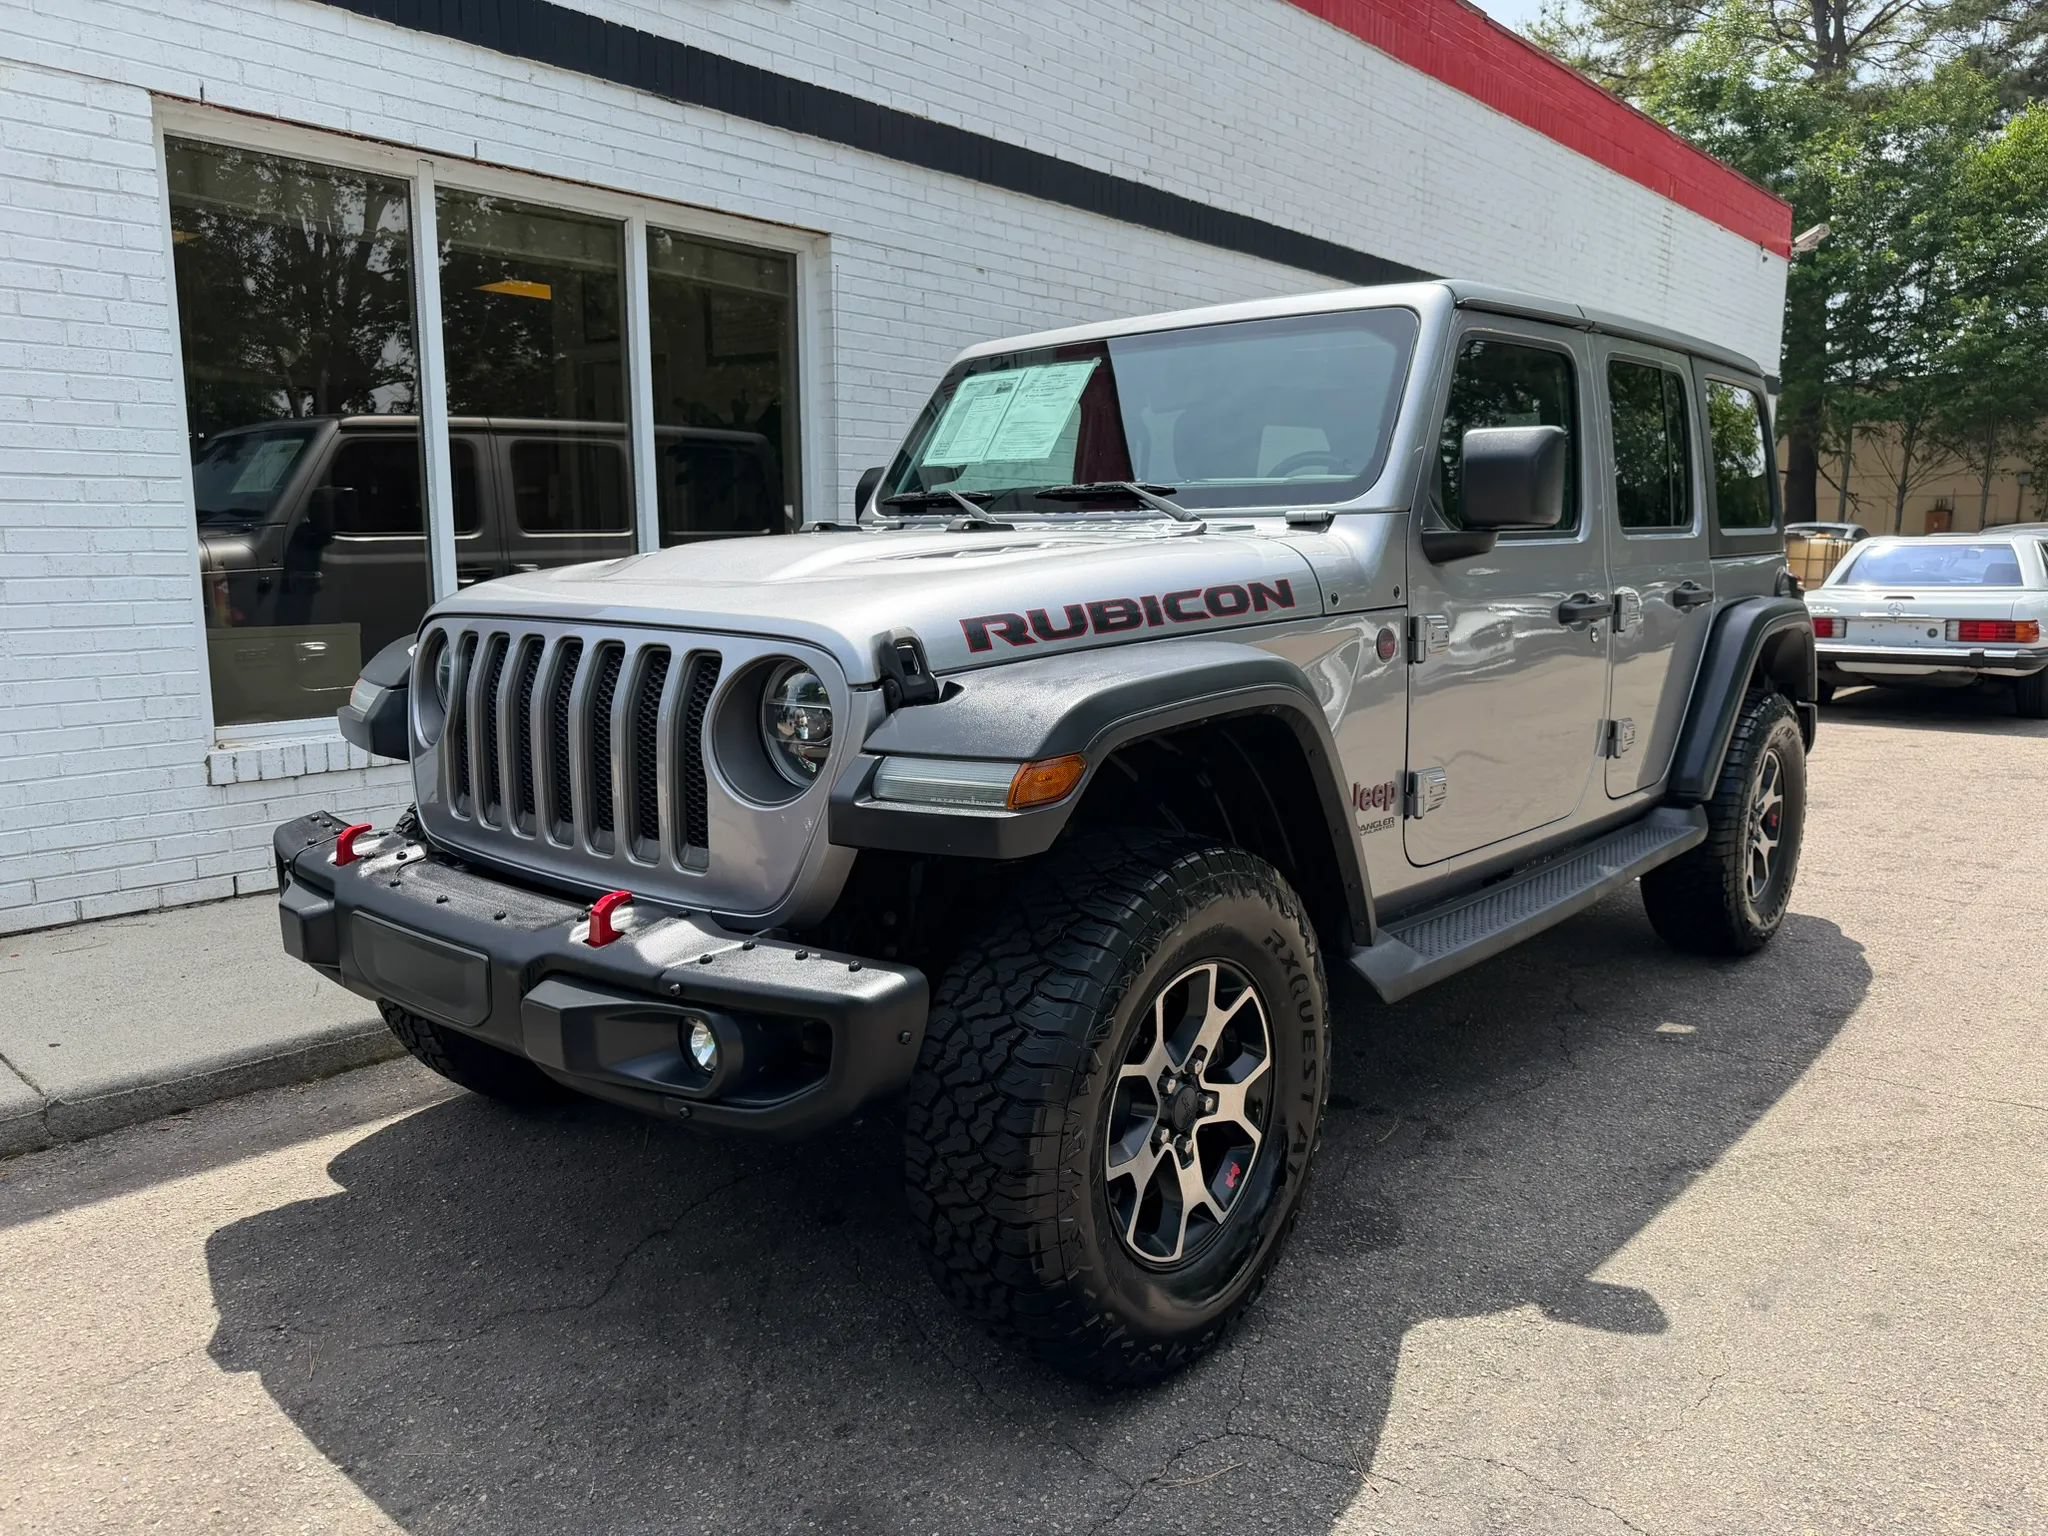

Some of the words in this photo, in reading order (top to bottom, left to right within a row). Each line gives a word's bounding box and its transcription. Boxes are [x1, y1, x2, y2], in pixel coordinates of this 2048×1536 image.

[959, 578, 1296, 653] RUBICON
[1358, 817, 1395, 832] ANGLER
[1263, 927, 1318, 1112] RXQUEST
